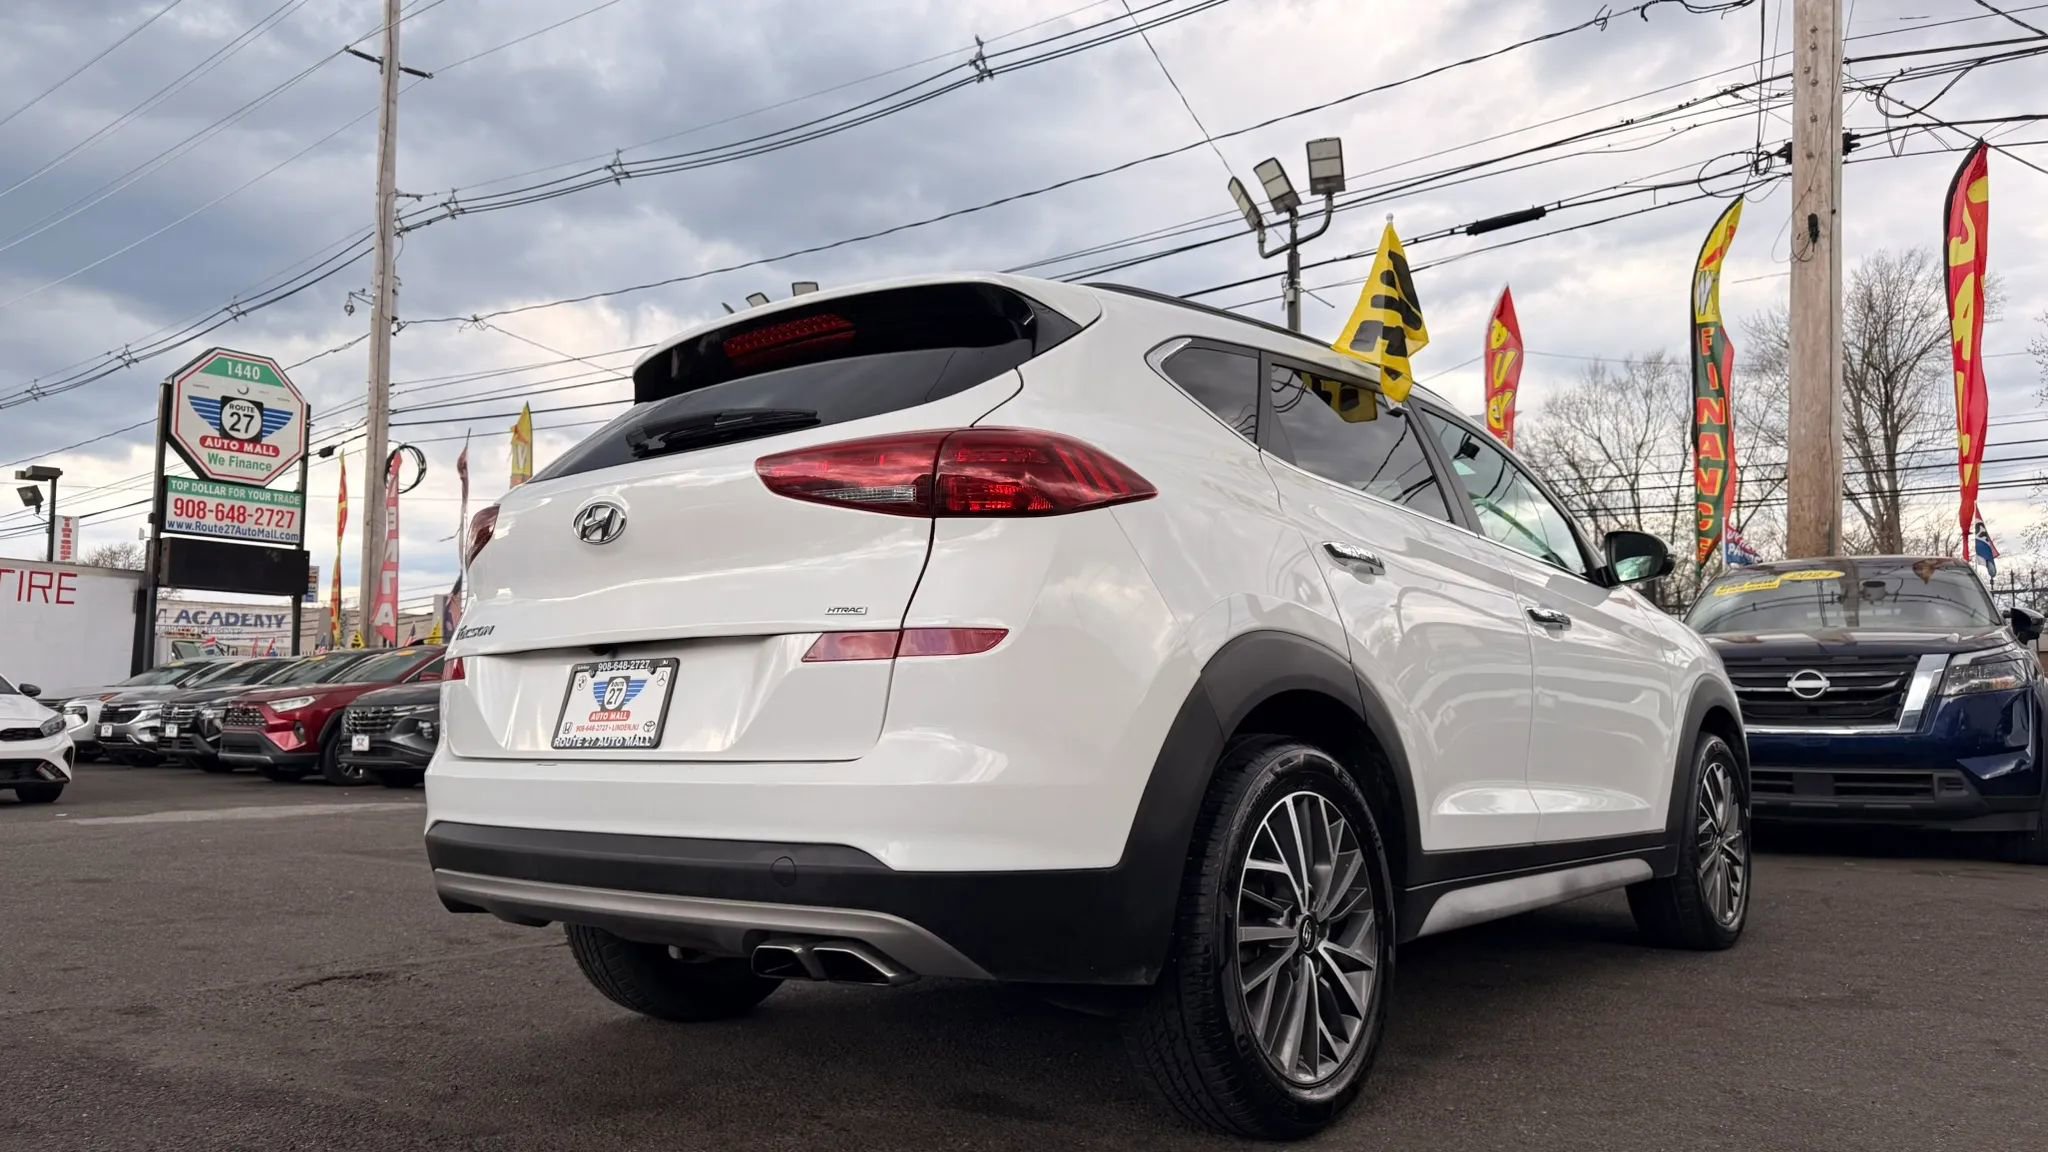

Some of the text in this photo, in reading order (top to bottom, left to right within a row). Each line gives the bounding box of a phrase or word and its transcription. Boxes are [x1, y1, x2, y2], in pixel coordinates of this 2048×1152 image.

[226, 361, 261, 381] 1440
[228, 403, 256, 414] ROUTE
[228, 411, 255, 435] 27
[203, 437, 277, 457] AUTO MALL
[1696, 327, 1727, 566] FINANCE
[207, 452, 273, 473] We Finance
[171, 479, 302, 506] TOP DOLLAR FOR YOUR TRADE
[173, 497, 296, 530] 908-648-2727
[167, 519, 300, 542] www.Route27AutoMall.com
[174, 609, 287, 629] ACADEMY
[825, 606, 867, 615] HTRAC
[598, 660, 651, 672] 908-648-2727
[606, 687, 624, 706] 27
[591, 710, 628, 721] AUTO MALL
[553, 735, 652, 748] ROUTE 27 AUTO MALL
